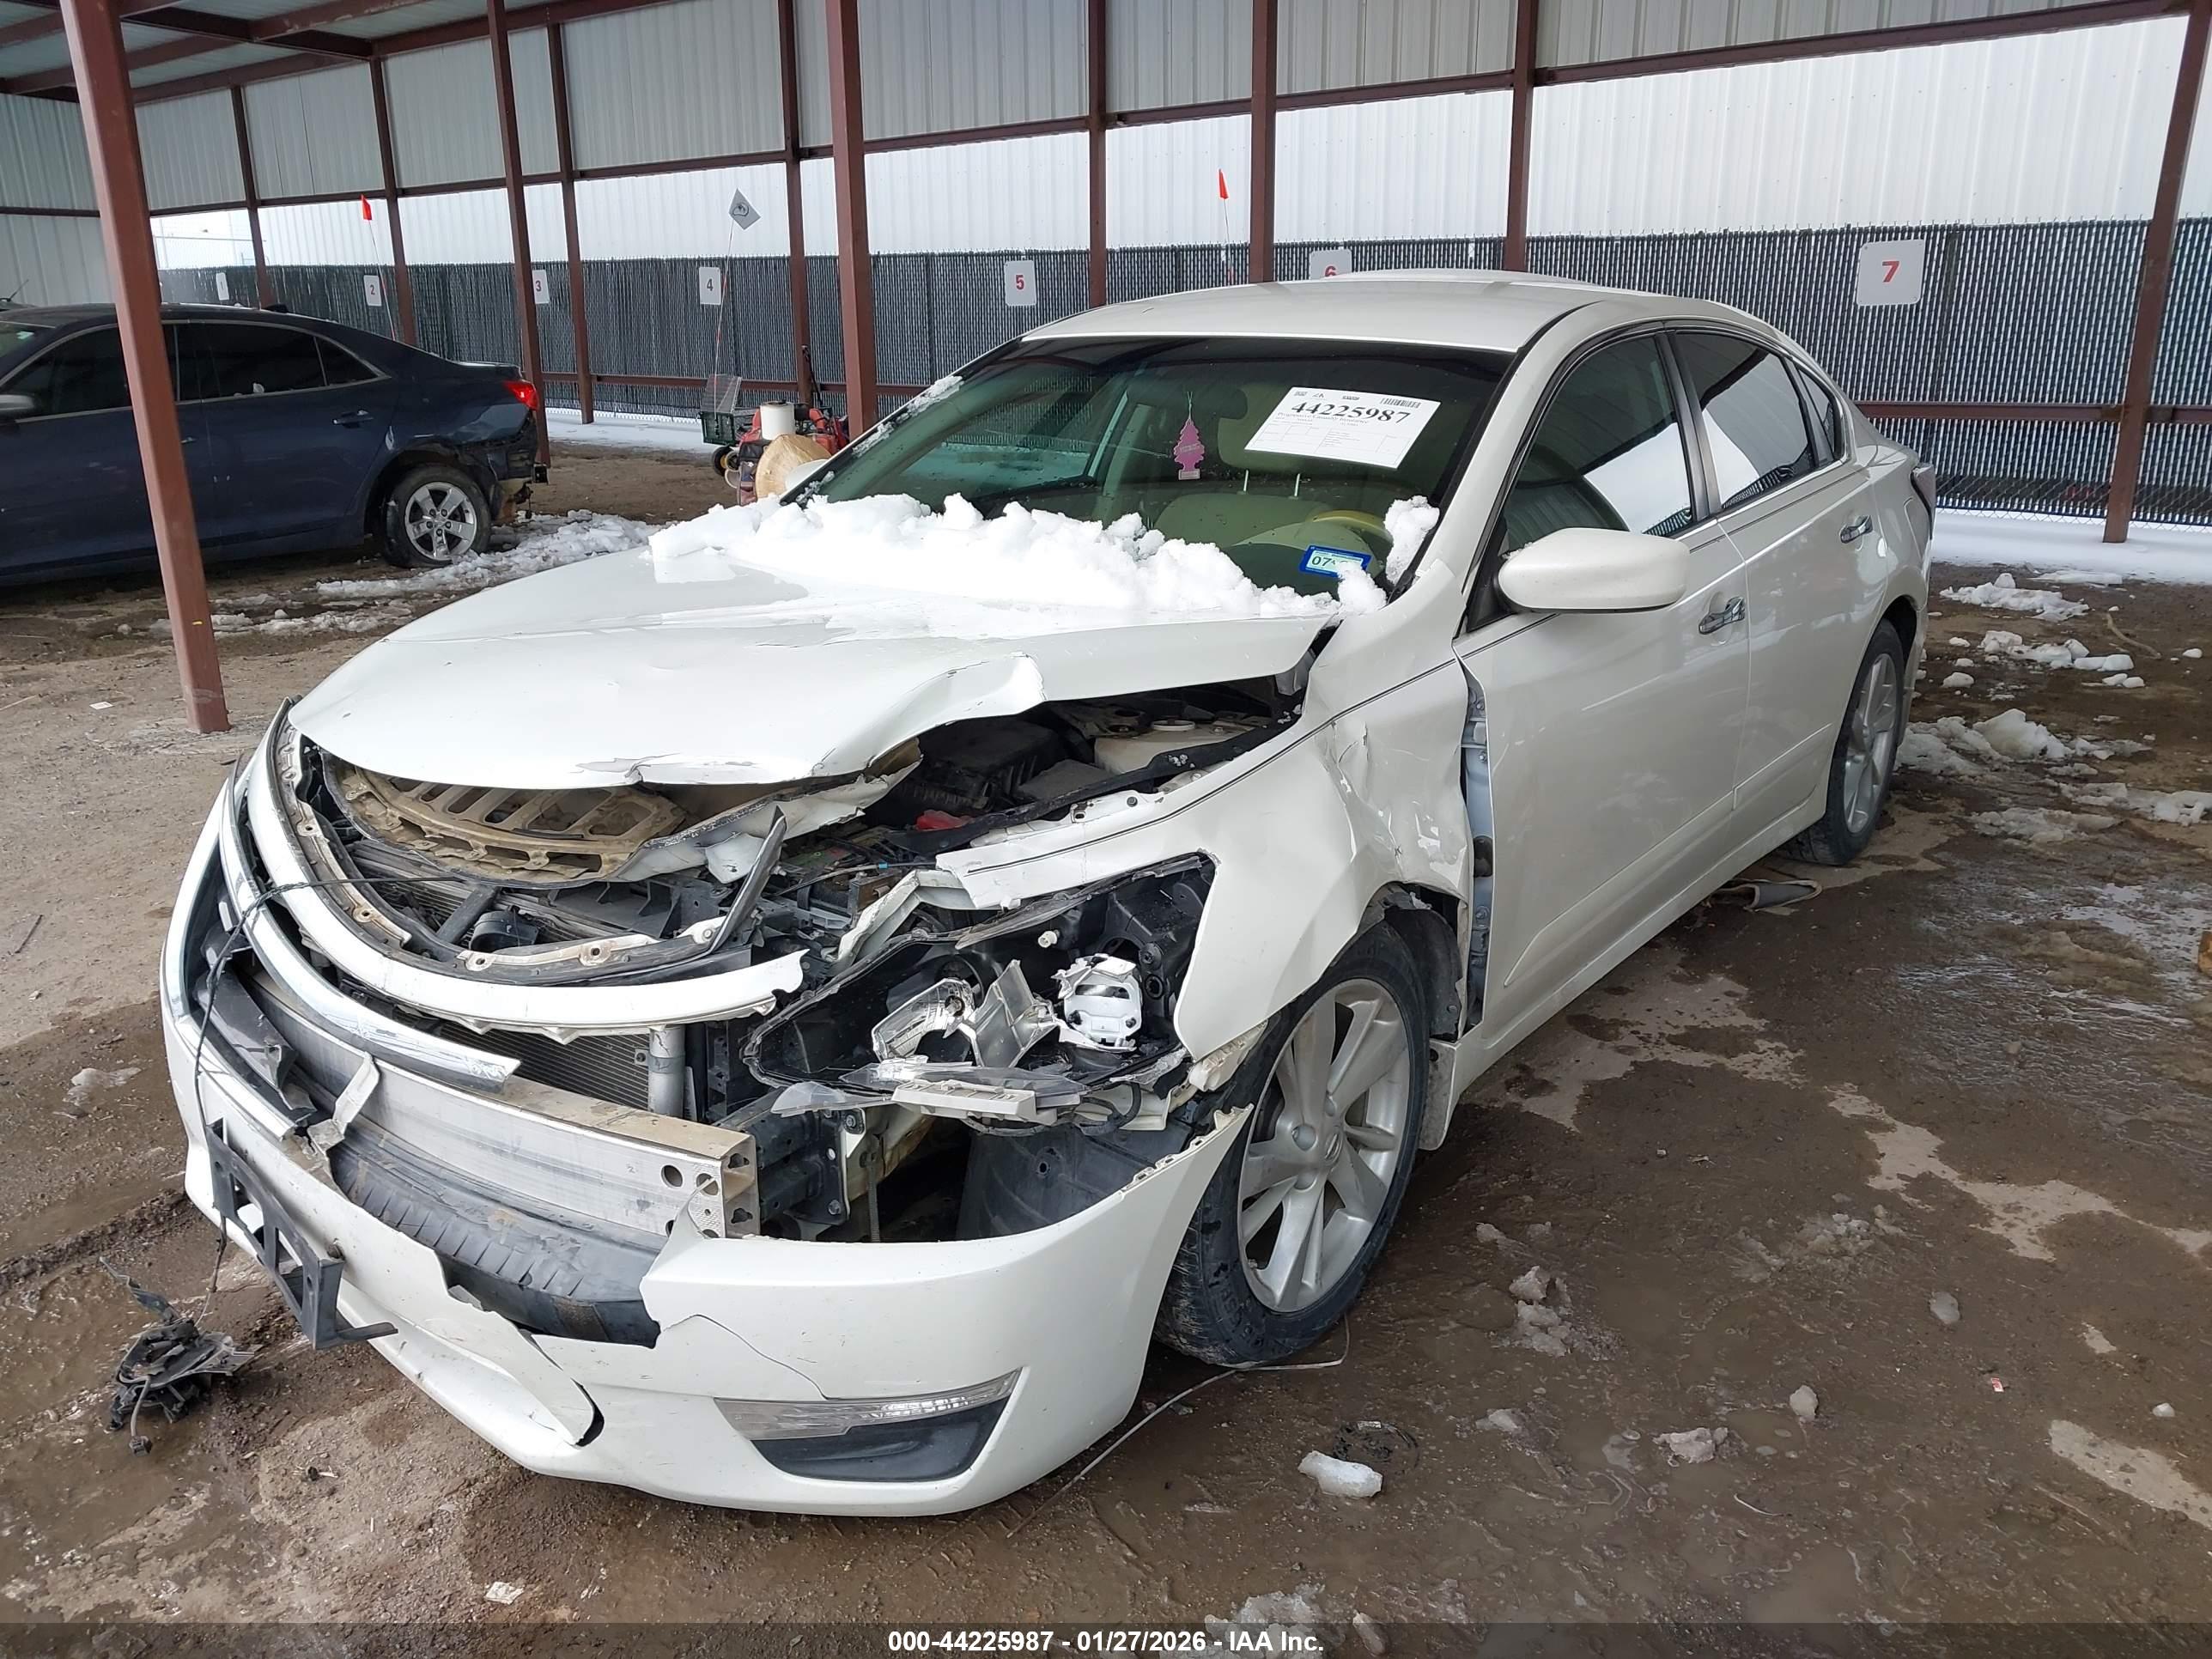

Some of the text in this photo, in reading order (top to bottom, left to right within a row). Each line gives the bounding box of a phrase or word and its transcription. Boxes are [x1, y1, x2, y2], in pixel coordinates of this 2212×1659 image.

[1881, 260, 1900, 283] 7
[535, 280, 542, 292] 3
[706, 278, 714, 292] 4
[1015, 274, 1024, 290] 5
[369, 284, 375, 295] 2
[1291, 401, 1412, 424] 44225987
[1311, 556, 1332, 567] 07
